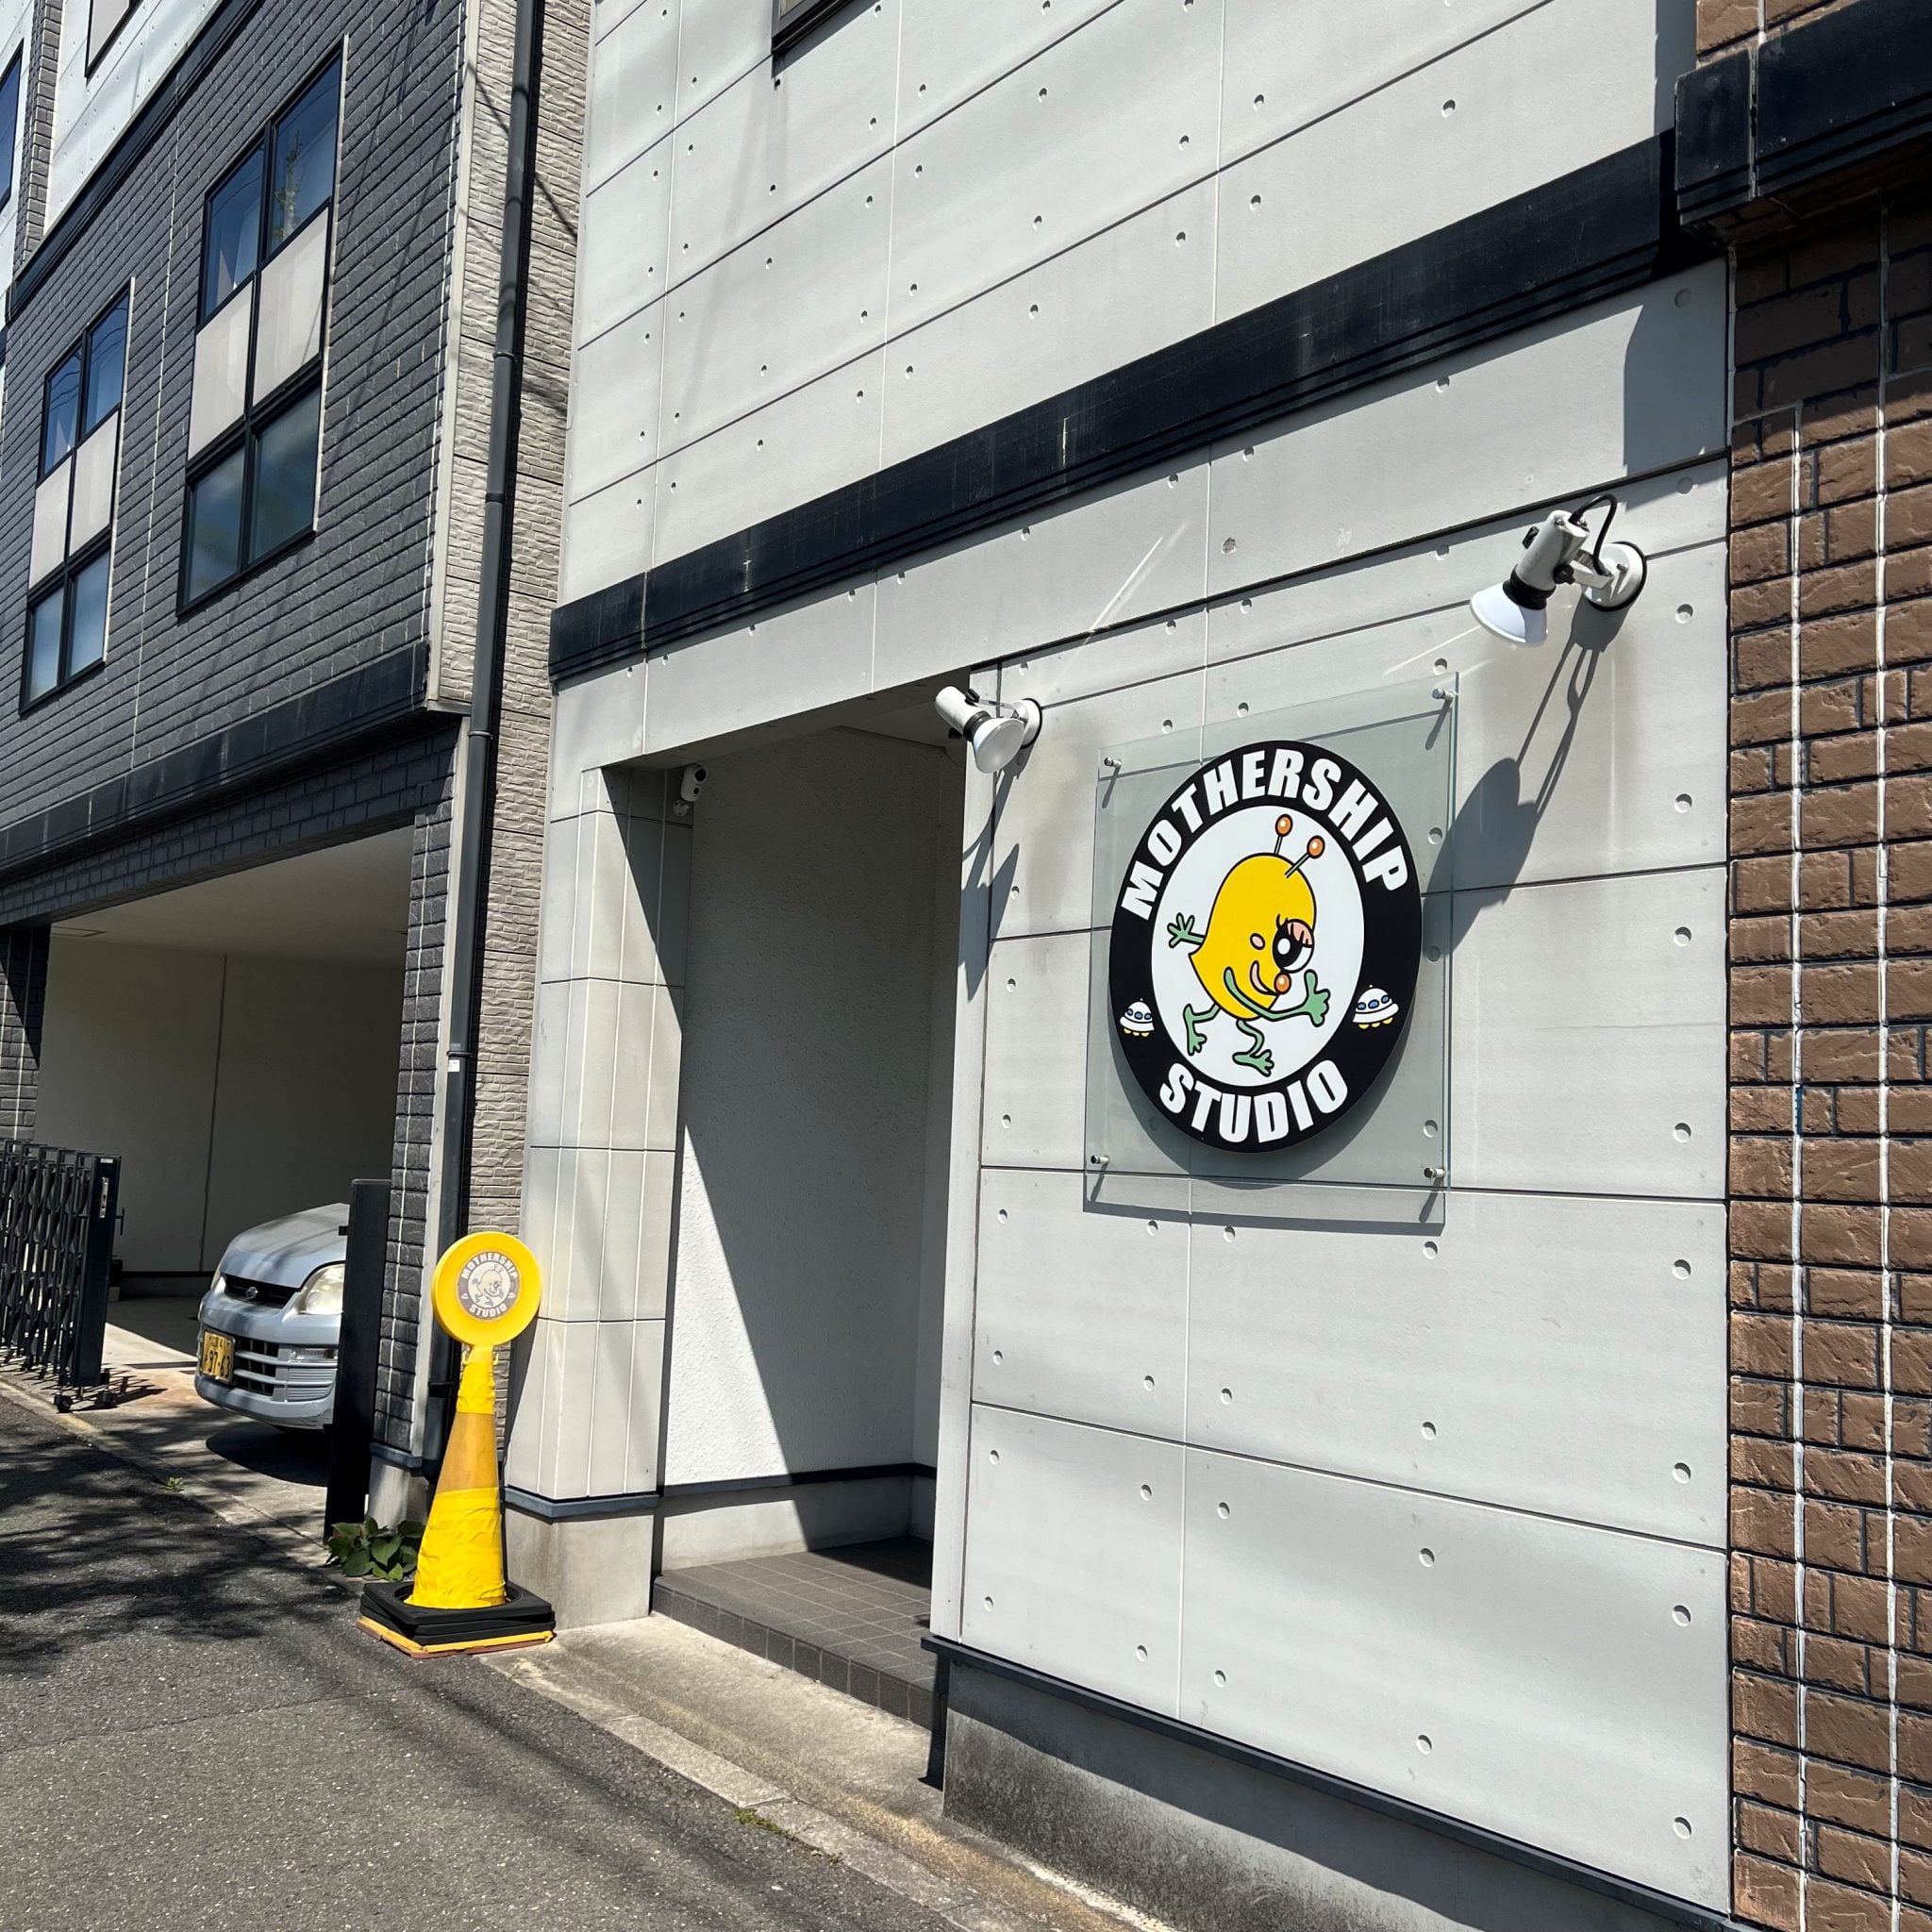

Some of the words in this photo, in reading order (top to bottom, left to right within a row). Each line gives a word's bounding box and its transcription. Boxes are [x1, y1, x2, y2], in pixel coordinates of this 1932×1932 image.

[1121, 748, 1408, 921] MOTHERSHIP
[1158, 1058, 1349, 1144] STUDIO
[460, 1252, 518, 1280] MOTHERSHIP
[469, 1303, 508, 1318] STUDIO
